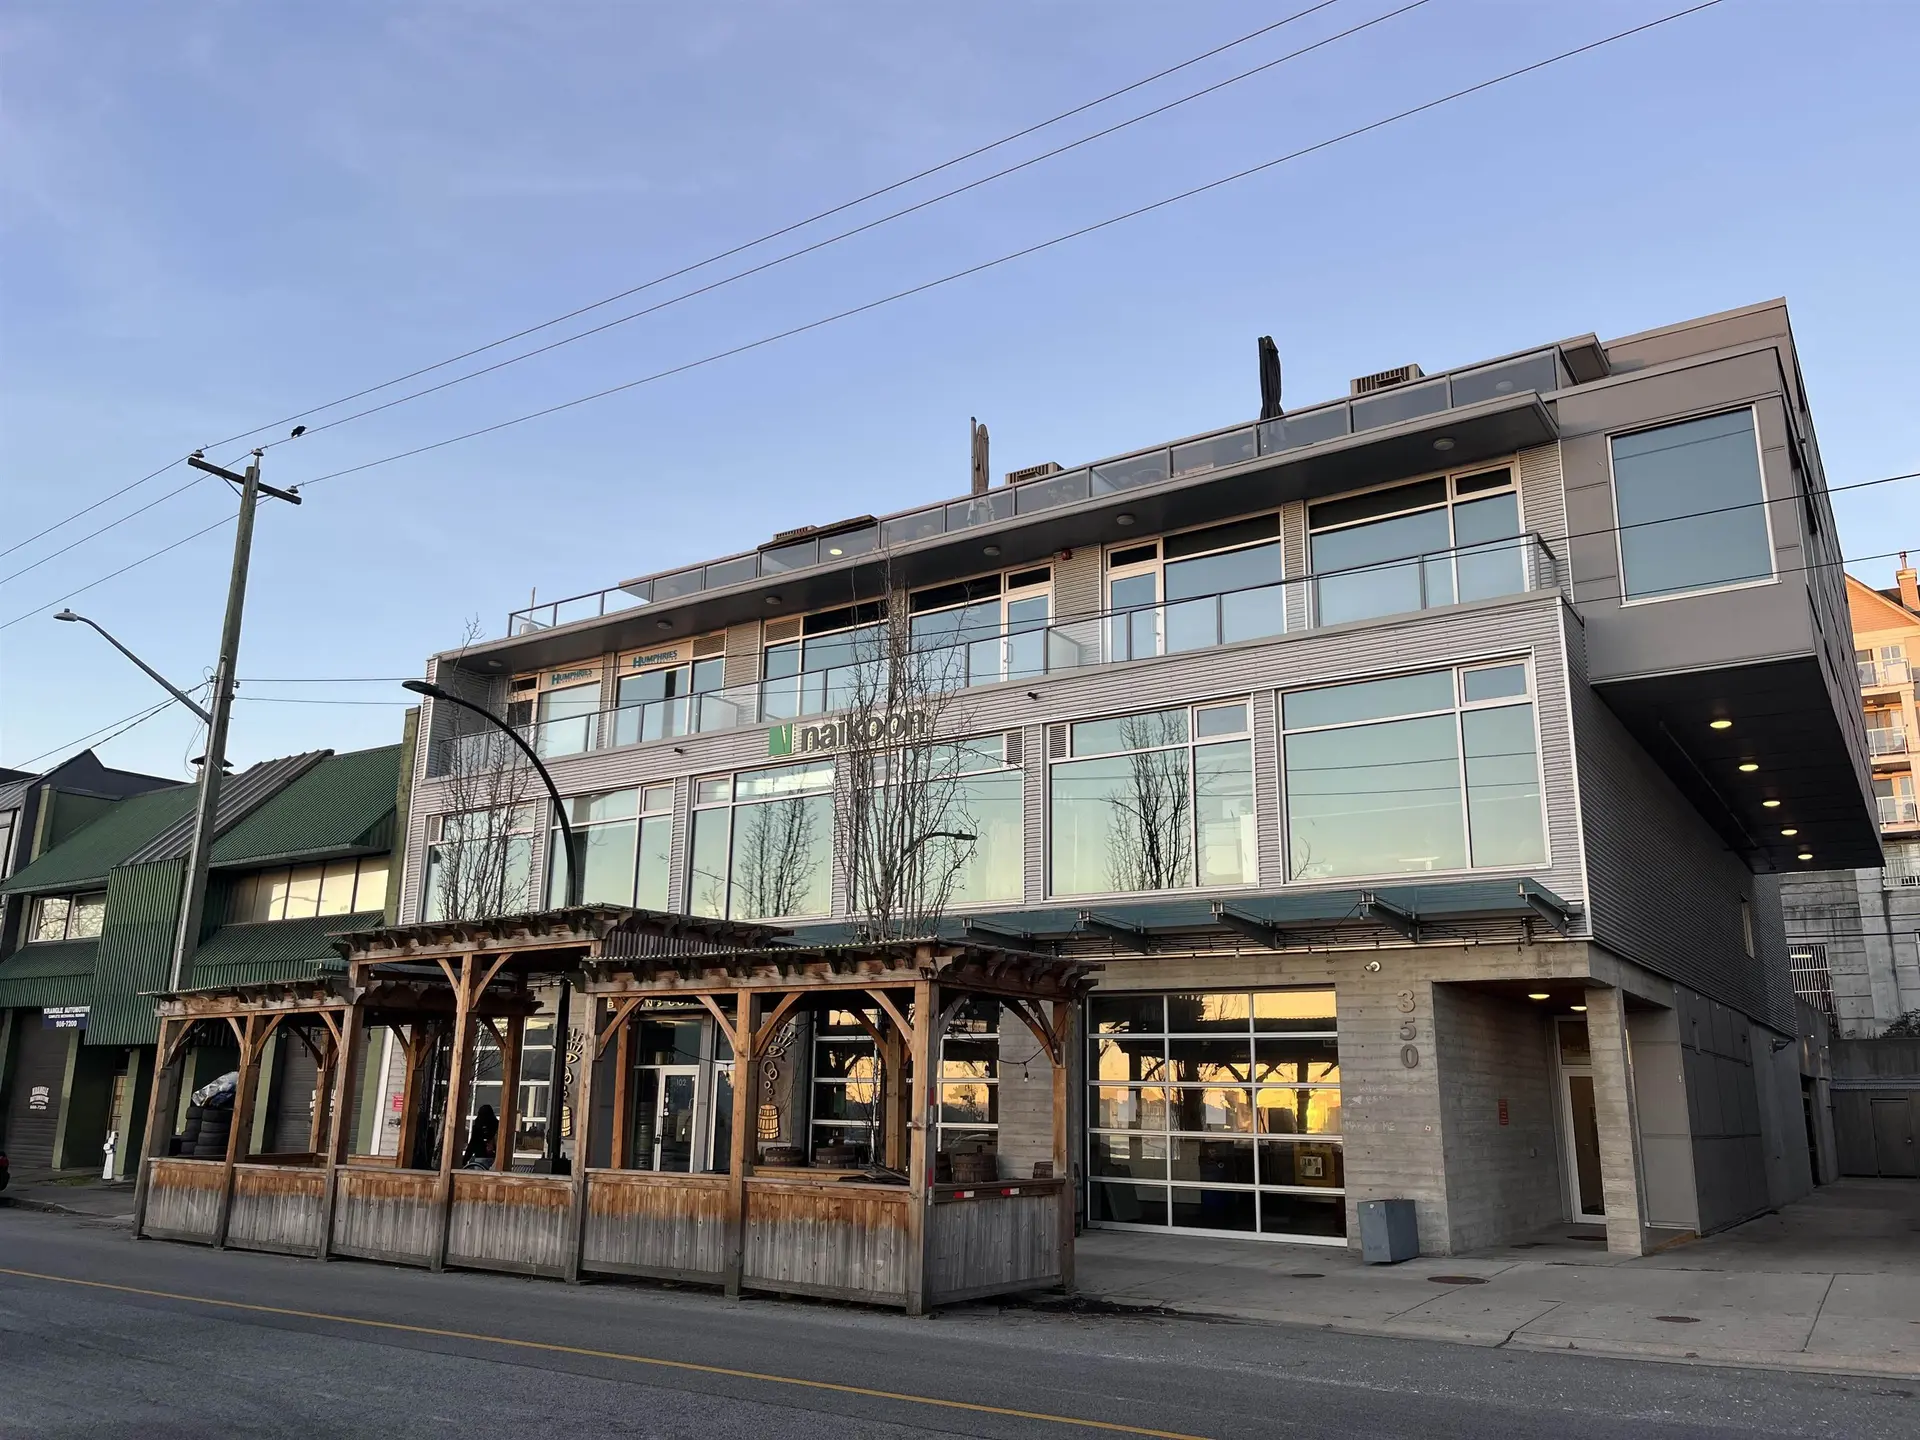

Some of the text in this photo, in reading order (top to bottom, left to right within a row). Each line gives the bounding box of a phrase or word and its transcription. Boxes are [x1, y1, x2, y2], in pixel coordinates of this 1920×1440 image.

[632, 650, 677, 668] HUMPHRIES
[551, 669, 592, 685] HUMPHRIES
[801, 709, 926, 751] naikoon
[1396, 989, 1419, 1069] 350
[676, 1079, 687, 1087] 102
